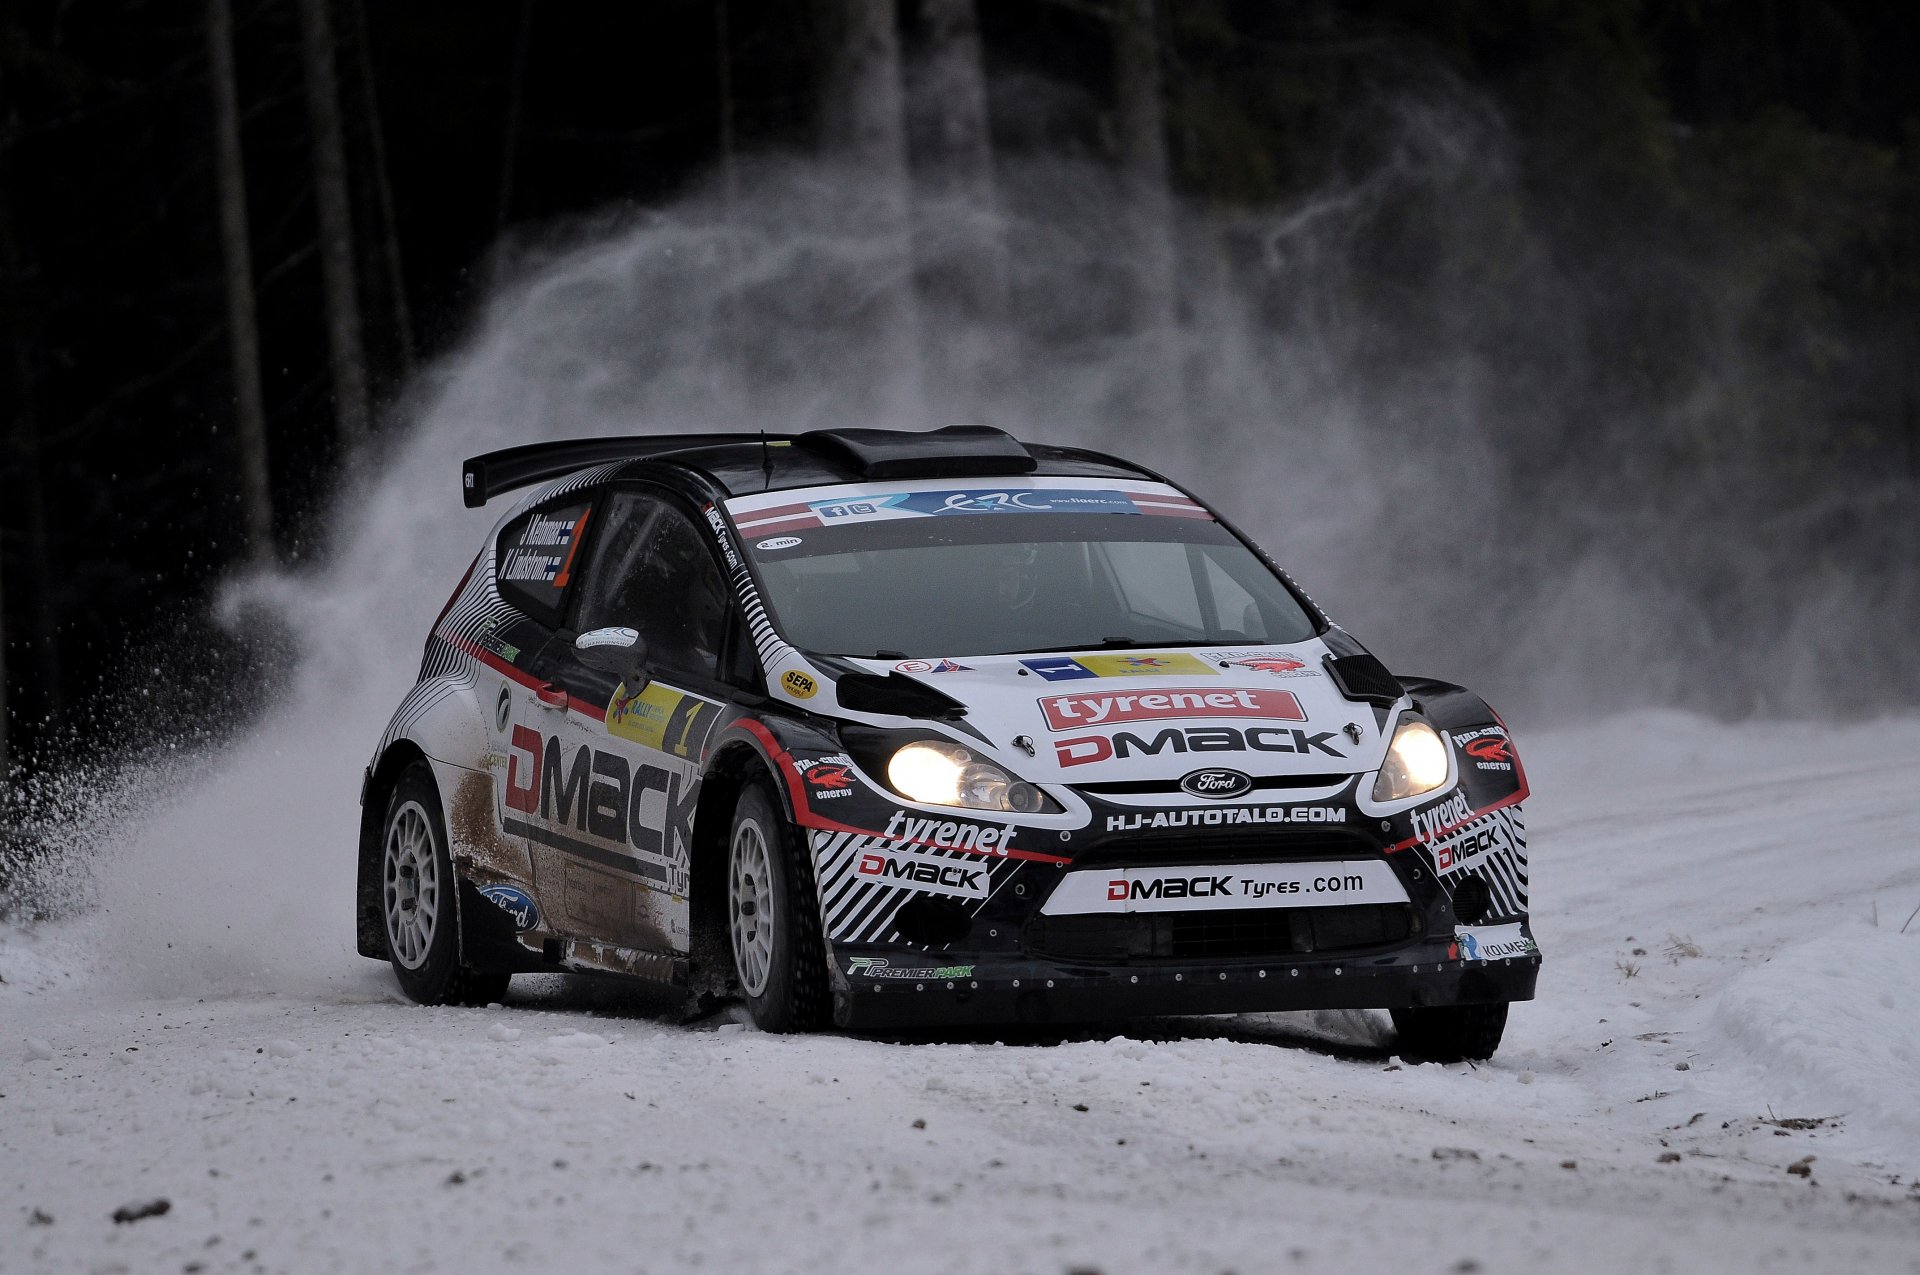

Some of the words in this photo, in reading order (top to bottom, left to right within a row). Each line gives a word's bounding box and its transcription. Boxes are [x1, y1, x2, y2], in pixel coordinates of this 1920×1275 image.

[519, 513, 535, 546] J
[776, 538, 799, 546] min
[497, 548, 515, 580] K
[786, 671, 814, 693] SEPA
[1052, 690, 1261, 722] tyrenet
[674, 702, 704, 756] 1
[1476, 762, 1511, 771] energy
[816, 789, 853, 799] energy
[1197, 774, 1236, 790] Ford
[1106, 807, 1346, 832] HJ-AUTOTALO.COM
[1410, 787, 1475, 846] tyrenet
[883, 810, 1018, 856] tyrenet
